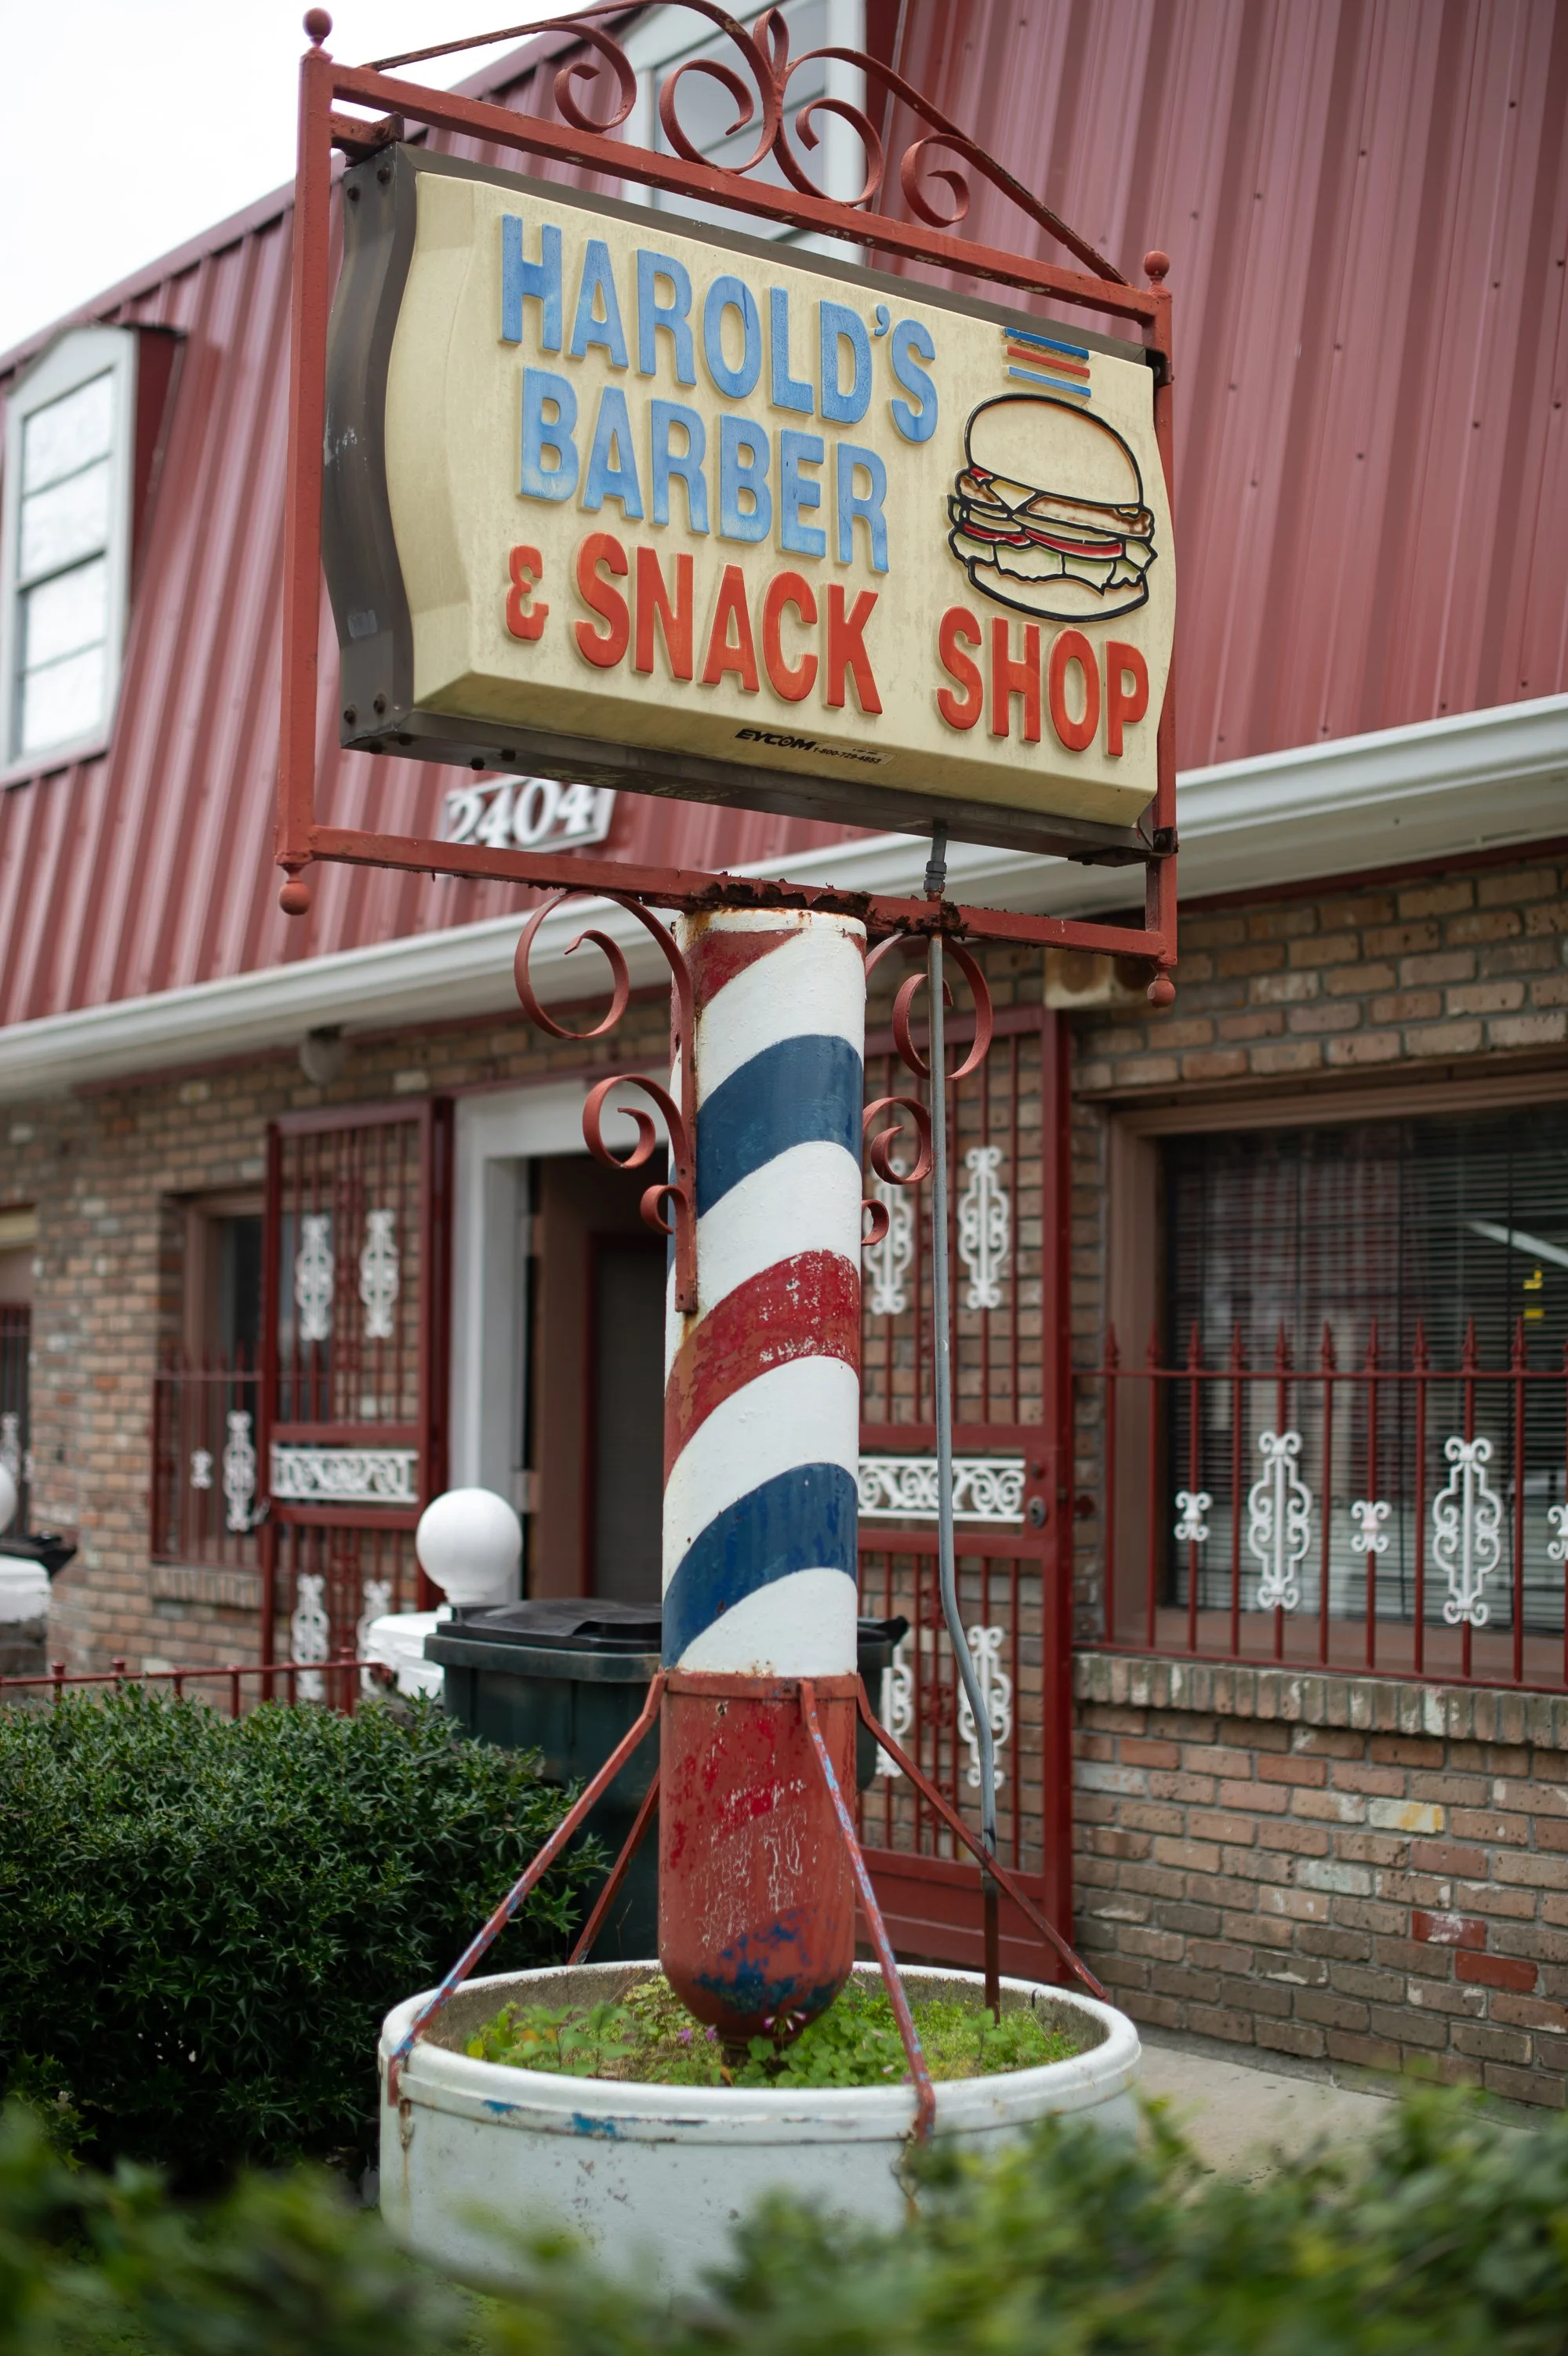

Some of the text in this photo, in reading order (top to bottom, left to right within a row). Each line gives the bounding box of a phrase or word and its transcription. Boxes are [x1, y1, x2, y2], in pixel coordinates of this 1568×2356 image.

[500, 212, 938, 444] HAROLD'S
[518, 365, 890, 575] BARBER
[505, 531, 1150, 757] & SNACK SHOP
[734, 727, 818, 752] EYCOM
[445, 779, 597, 849] 2404
